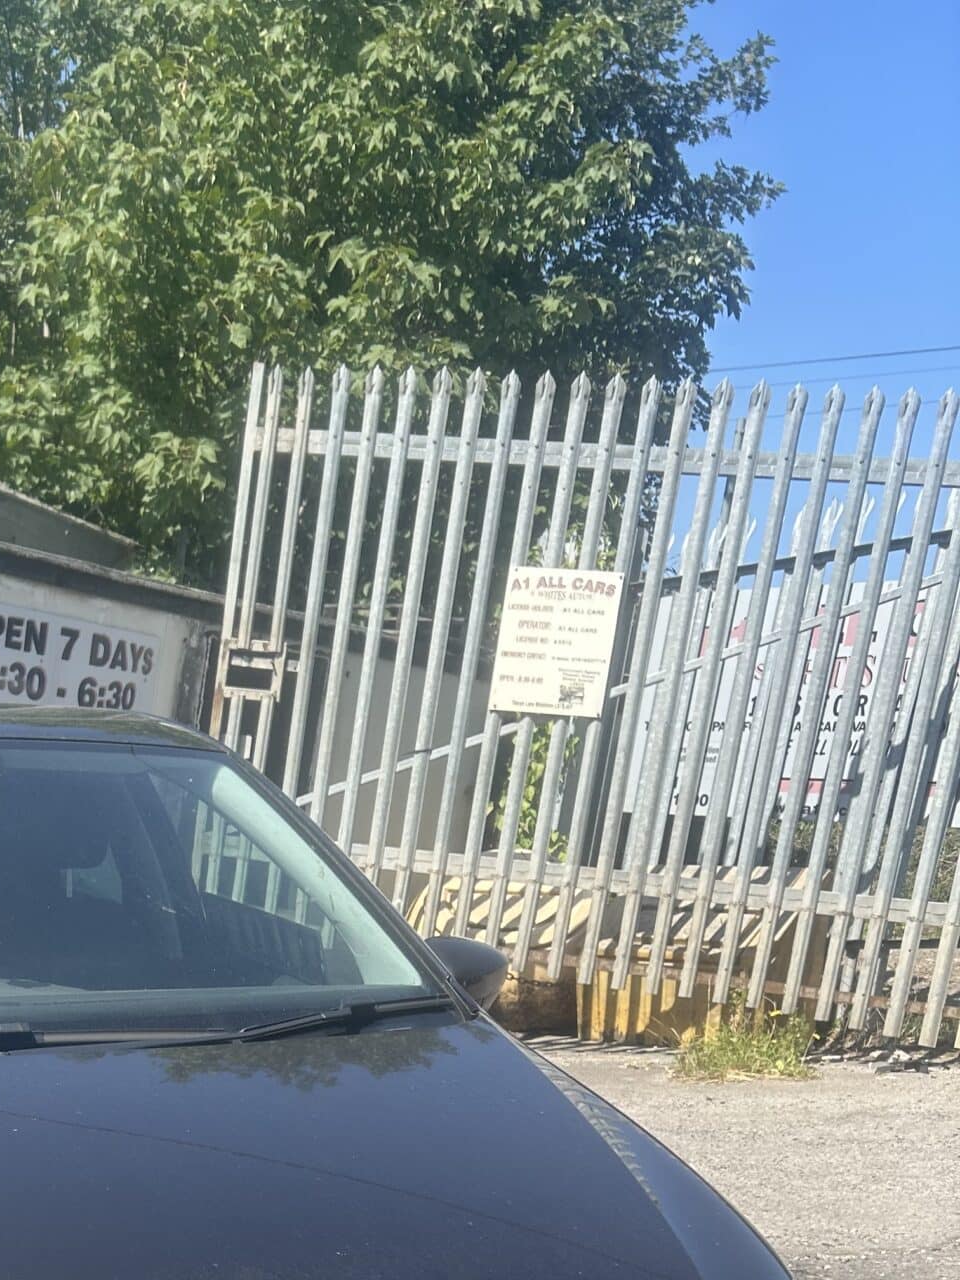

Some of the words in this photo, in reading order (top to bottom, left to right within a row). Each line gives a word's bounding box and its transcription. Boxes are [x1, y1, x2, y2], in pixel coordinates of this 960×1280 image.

[511, 577, 530, 592] A1
[536, 576, 566, 590] ALL
[571, 577, 617, 598] CARS
[60, 626, 80, 661] 7
[89, 632, 154, 676] DAYS
[77, 675, 136, 710] 6:30
